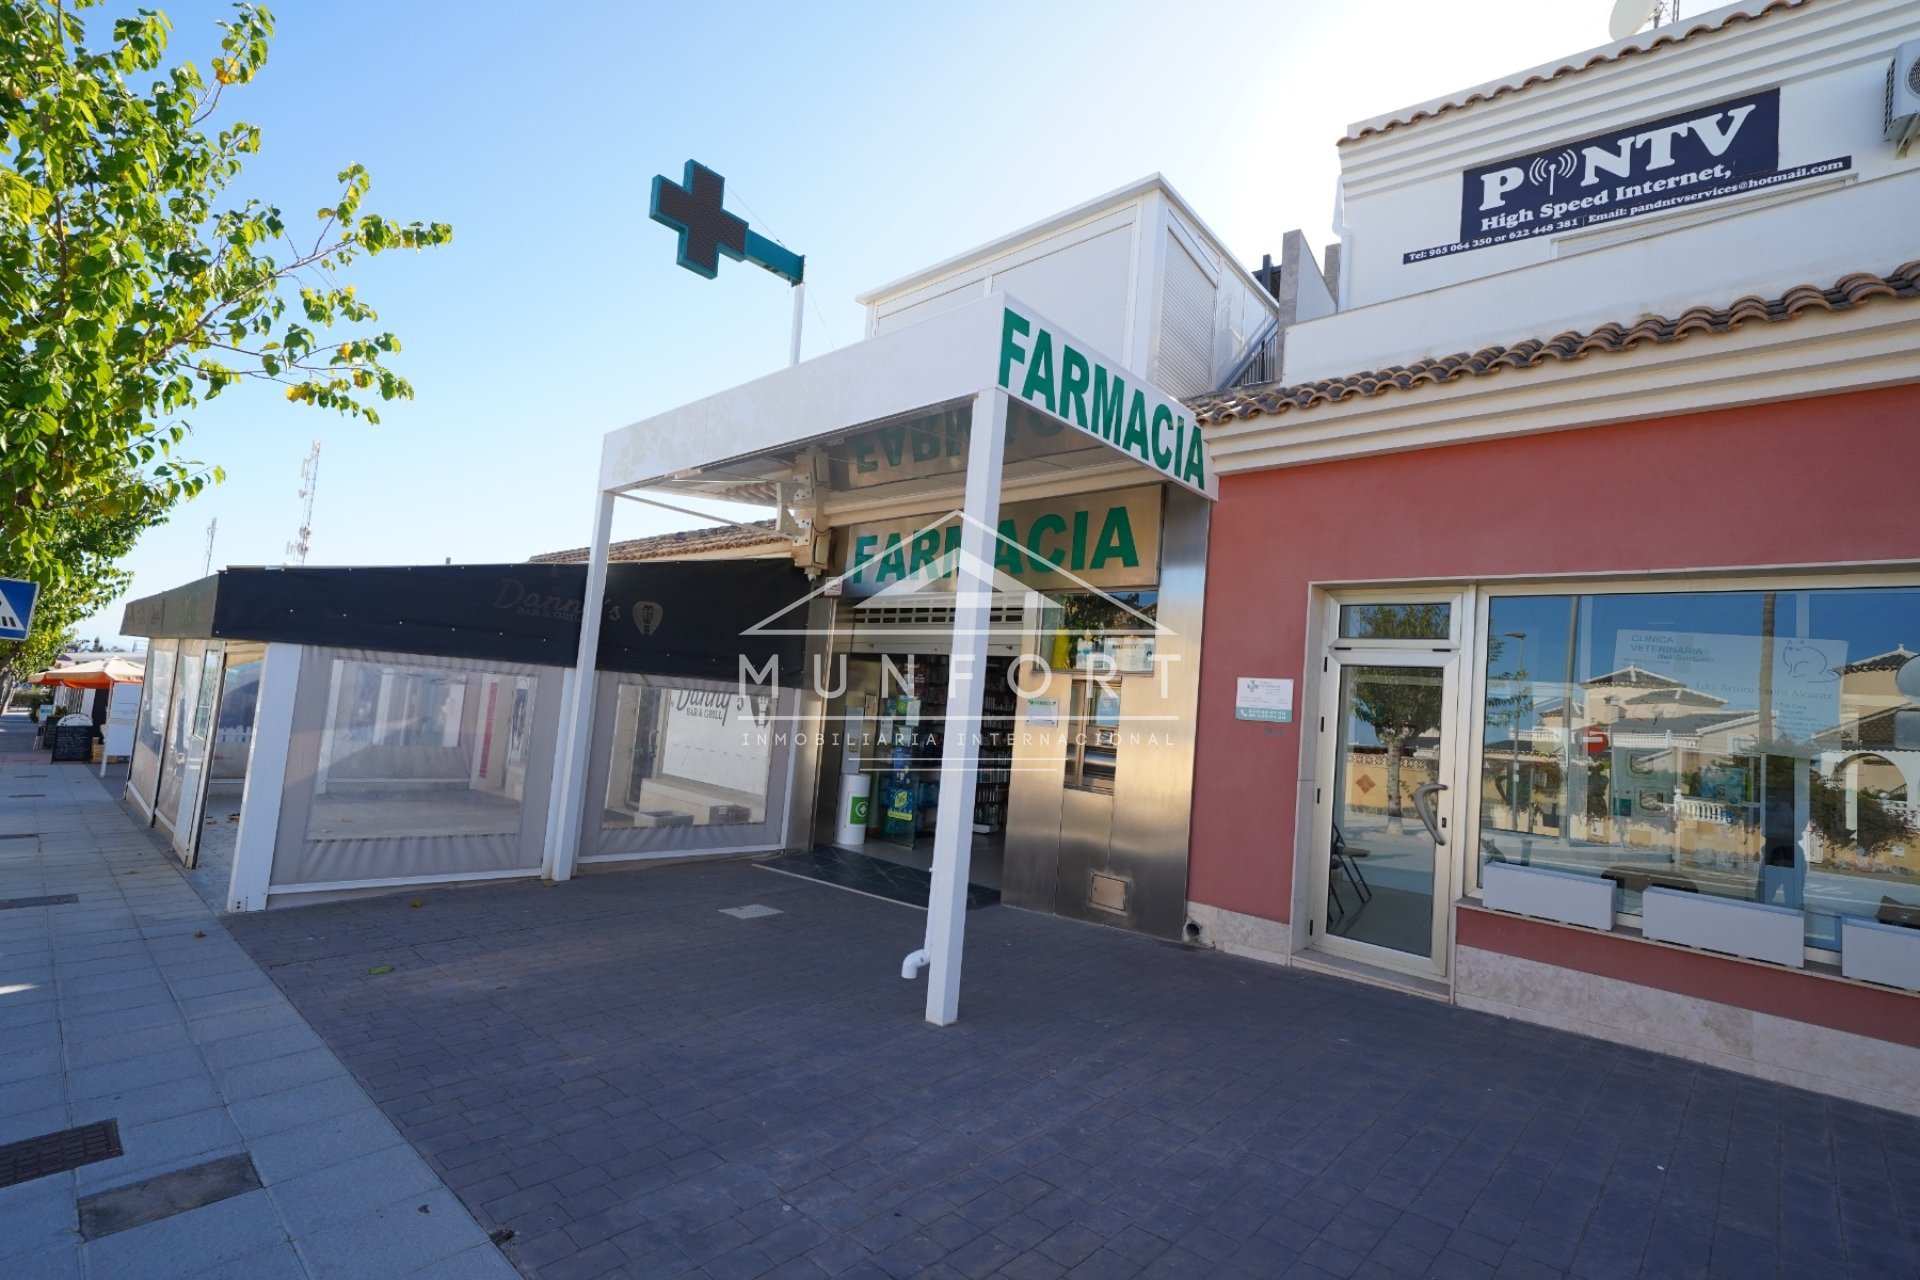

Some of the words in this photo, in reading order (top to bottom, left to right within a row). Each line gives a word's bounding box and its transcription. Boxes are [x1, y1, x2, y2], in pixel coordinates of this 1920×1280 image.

[1408, 252, 1427, 261] Tel:
[1429, 246, 1448, 257] 965
[1450, 241, 1470, 252] 064
[1472, 237, 1492, 247] 350
[1494, 234, 1507, 243] or
[1509, 230, 1530, 240] 622
[1532, 224, 1553, 235] 448
[1556, 218, 1578, 229] 381
[1587, 206, 1628, 223] Email:
[1630, 160, 1843, 216] pandntvservices@hotmail.com
[1480, 209, 1534, 231] High
[1540, 190, 1609, 218] Speed
[1615, 163, 1731, 202] Internet,
[998, 306, 1205, 491] FARMACIA
[493, 577, 621, 621] Dann's
